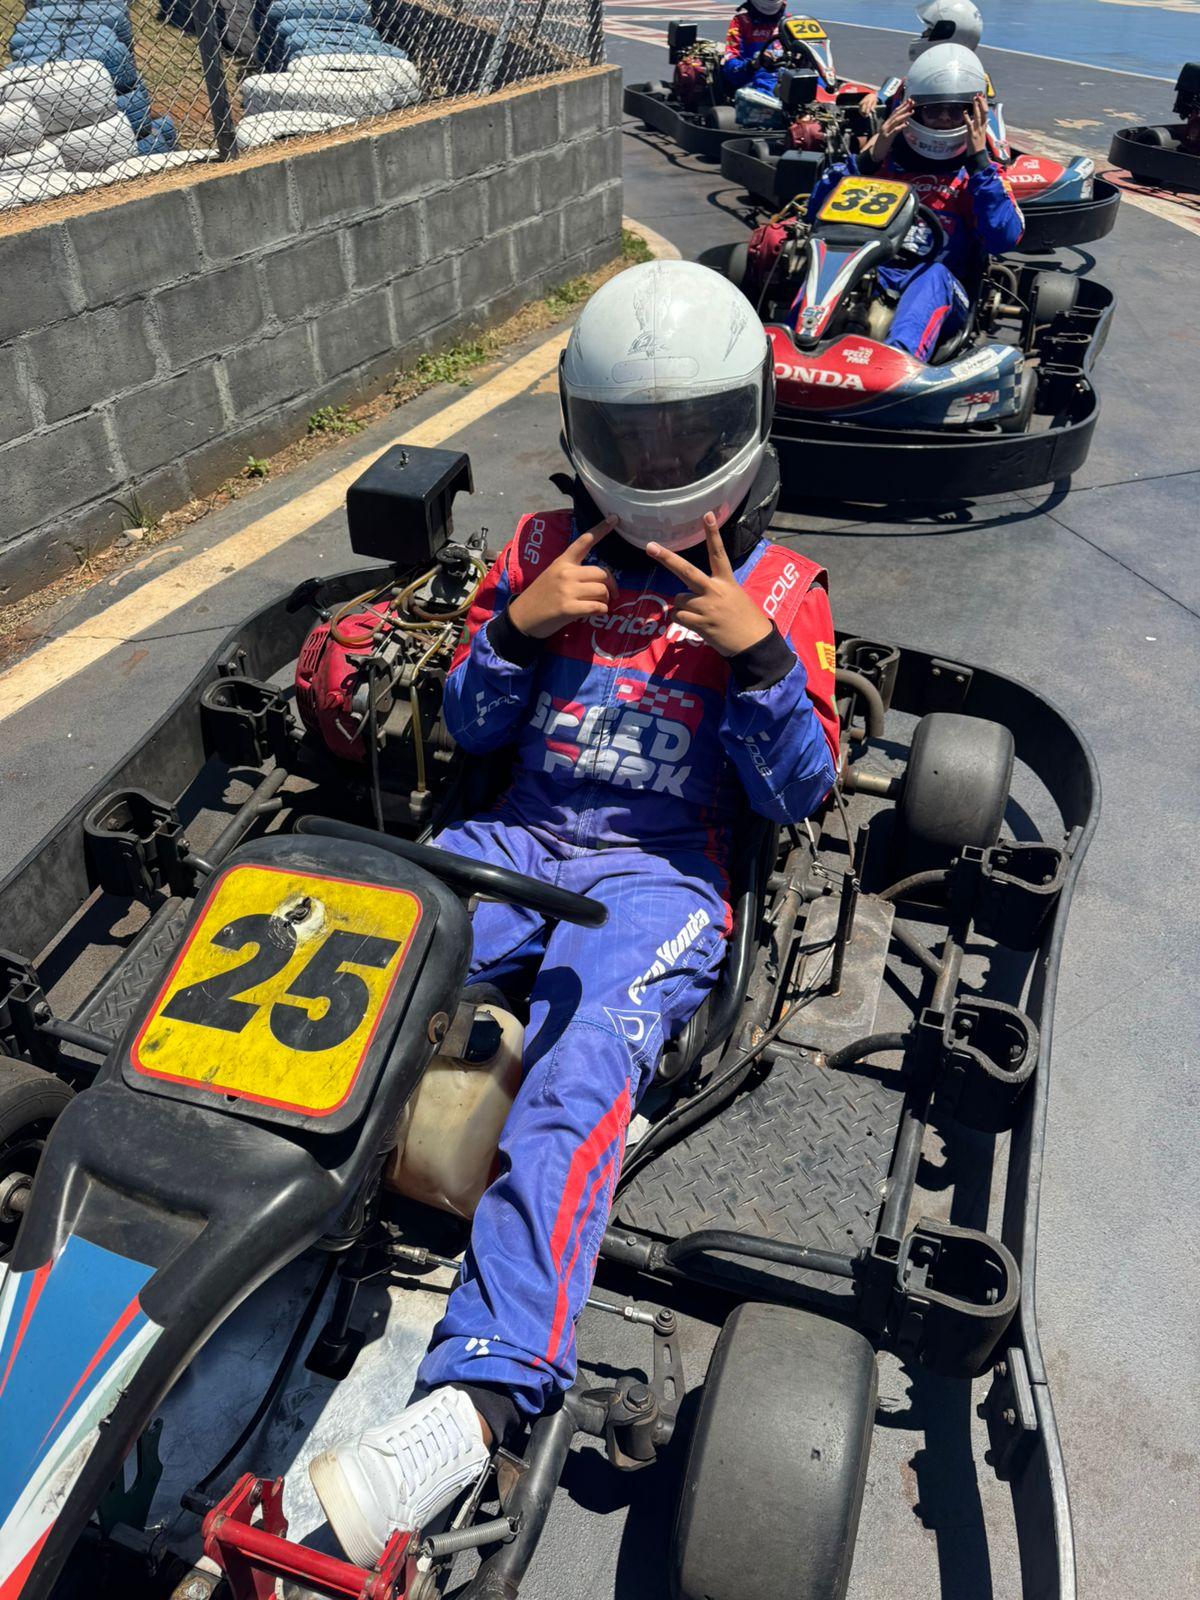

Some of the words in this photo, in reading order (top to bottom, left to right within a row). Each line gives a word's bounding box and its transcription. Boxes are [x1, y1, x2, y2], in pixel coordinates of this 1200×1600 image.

[793, 23, 820, 34] 20
[831, 188, 899, 215] 38
[774, 362, 867, 391] ONDA
[529, 690, 692, 763] SPEED
[543, 741, 692, 799] PARK
[159, 912, 403, 1052] 25
